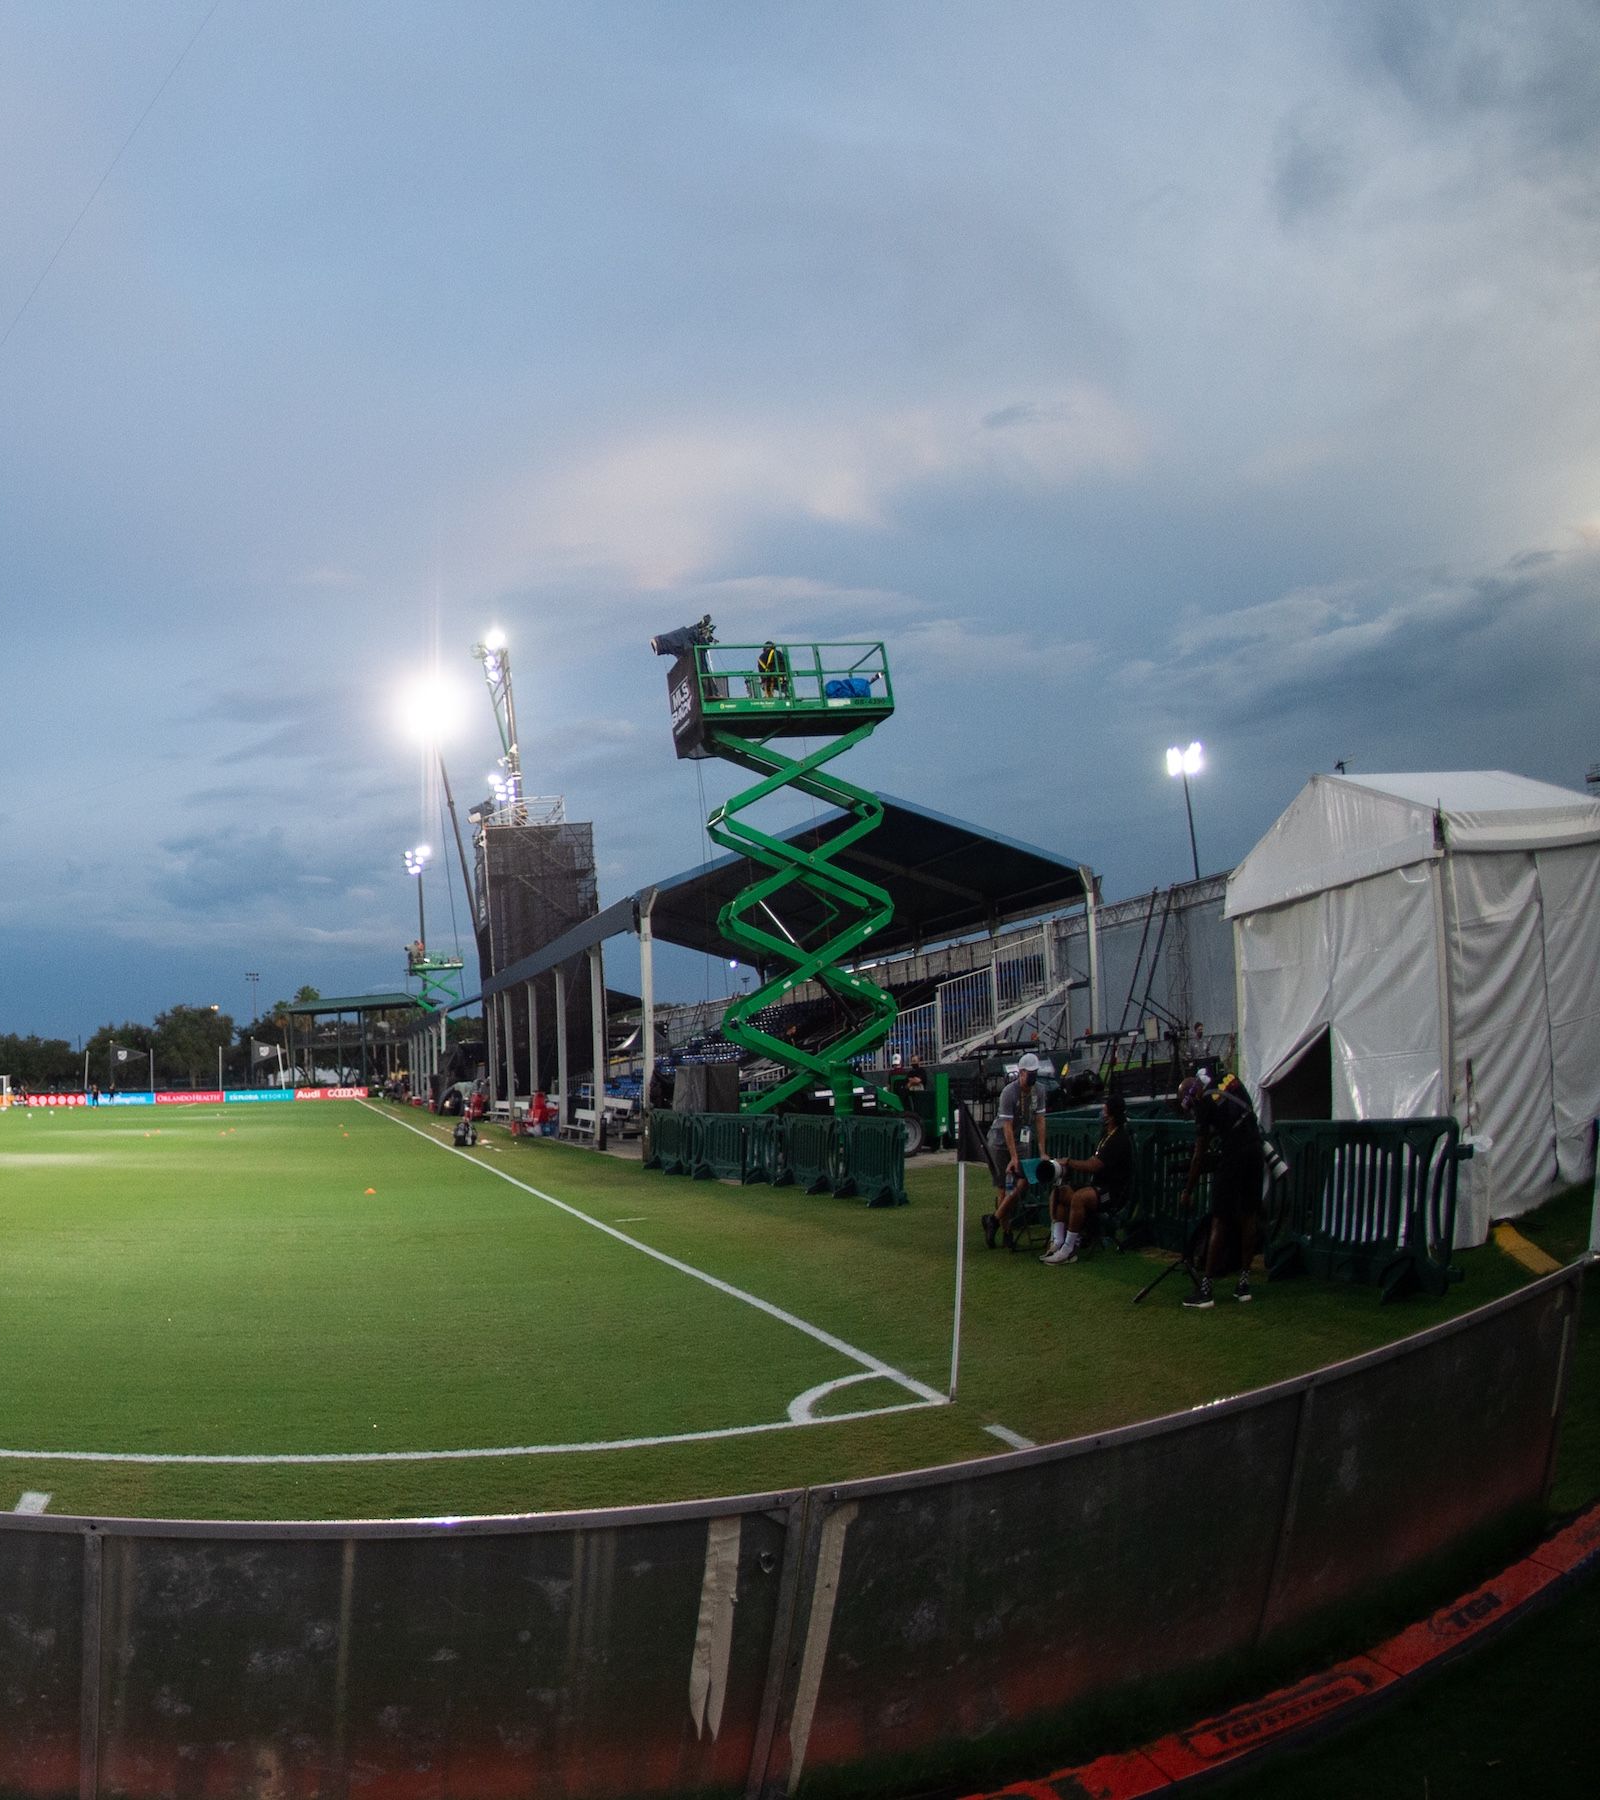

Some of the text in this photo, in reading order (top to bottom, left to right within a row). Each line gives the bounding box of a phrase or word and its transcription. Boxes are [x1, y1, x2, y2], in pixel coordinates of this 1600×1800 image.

[672, 682, 690, 711] MLS
[157, 1093, 221, 1102] ORLANDO HEALTH
[296, 1089, 321, 1099] Audi
[1451, 1592, 1502, 1629] TGI
